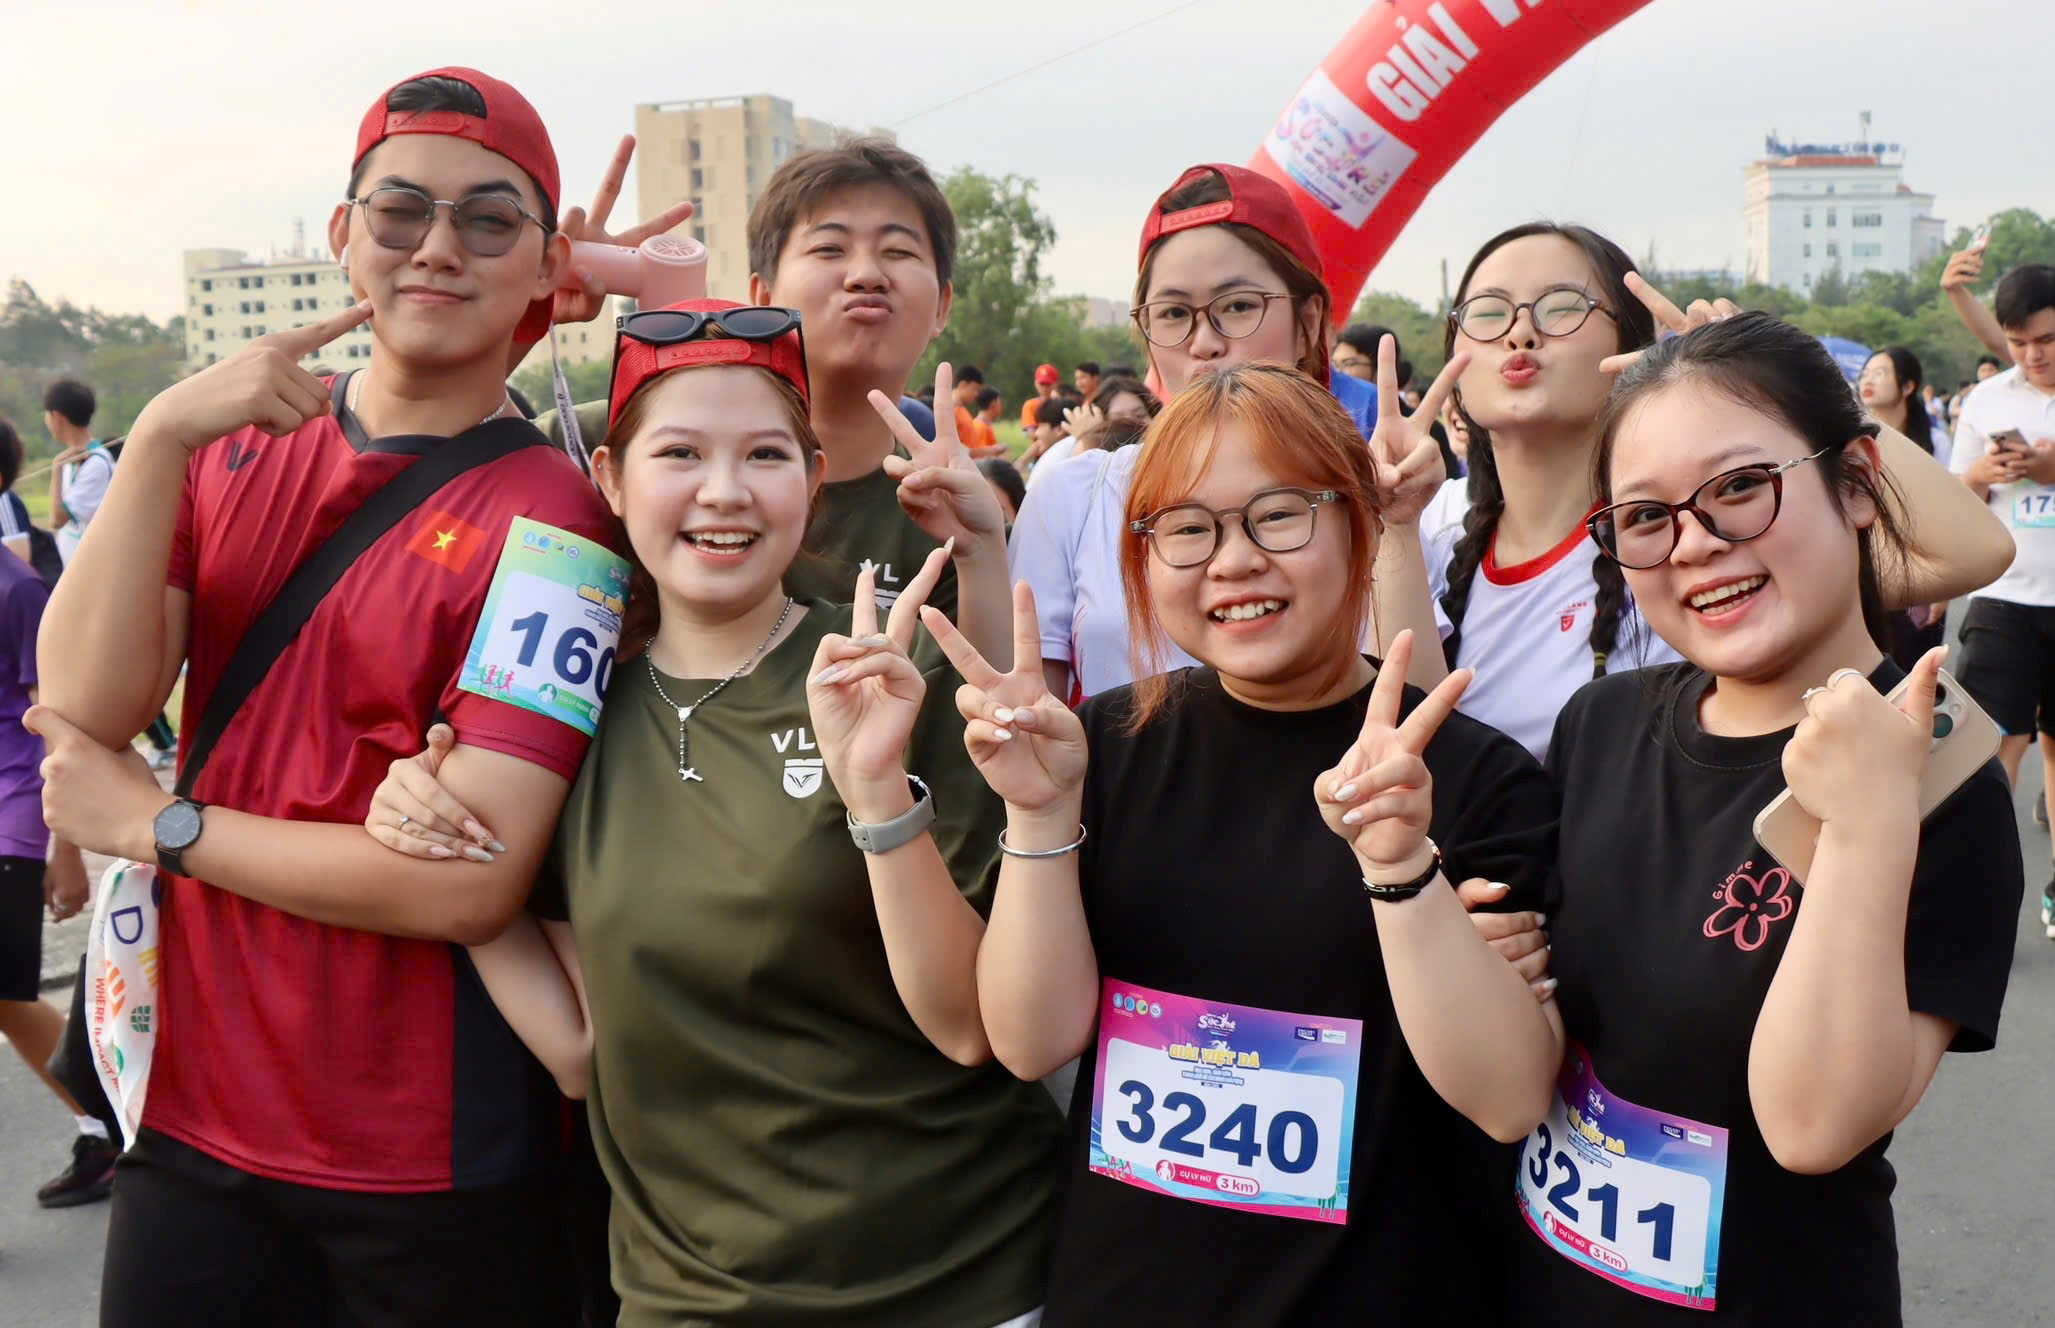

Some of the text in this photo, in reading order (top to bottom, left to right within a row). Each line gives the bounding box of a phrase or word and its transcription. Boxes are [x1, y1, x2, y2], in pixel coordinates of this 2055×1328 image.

[1366, 1, 1480, 122] GIẢI
[2021, 496, 2055, 514] 17
[95, 977, 105, 1024] WHERE
[1116, 1080, 1319, 1174] 3240
[1220, 1178, 1229, 1189] 3
[1232, 1179, 1254, 1193] km
[1529, 1122, 1675, 1262] 3211
[1593, 1247, 1601, 1258] 3
[1603, 1251, 1622, 1269] km
